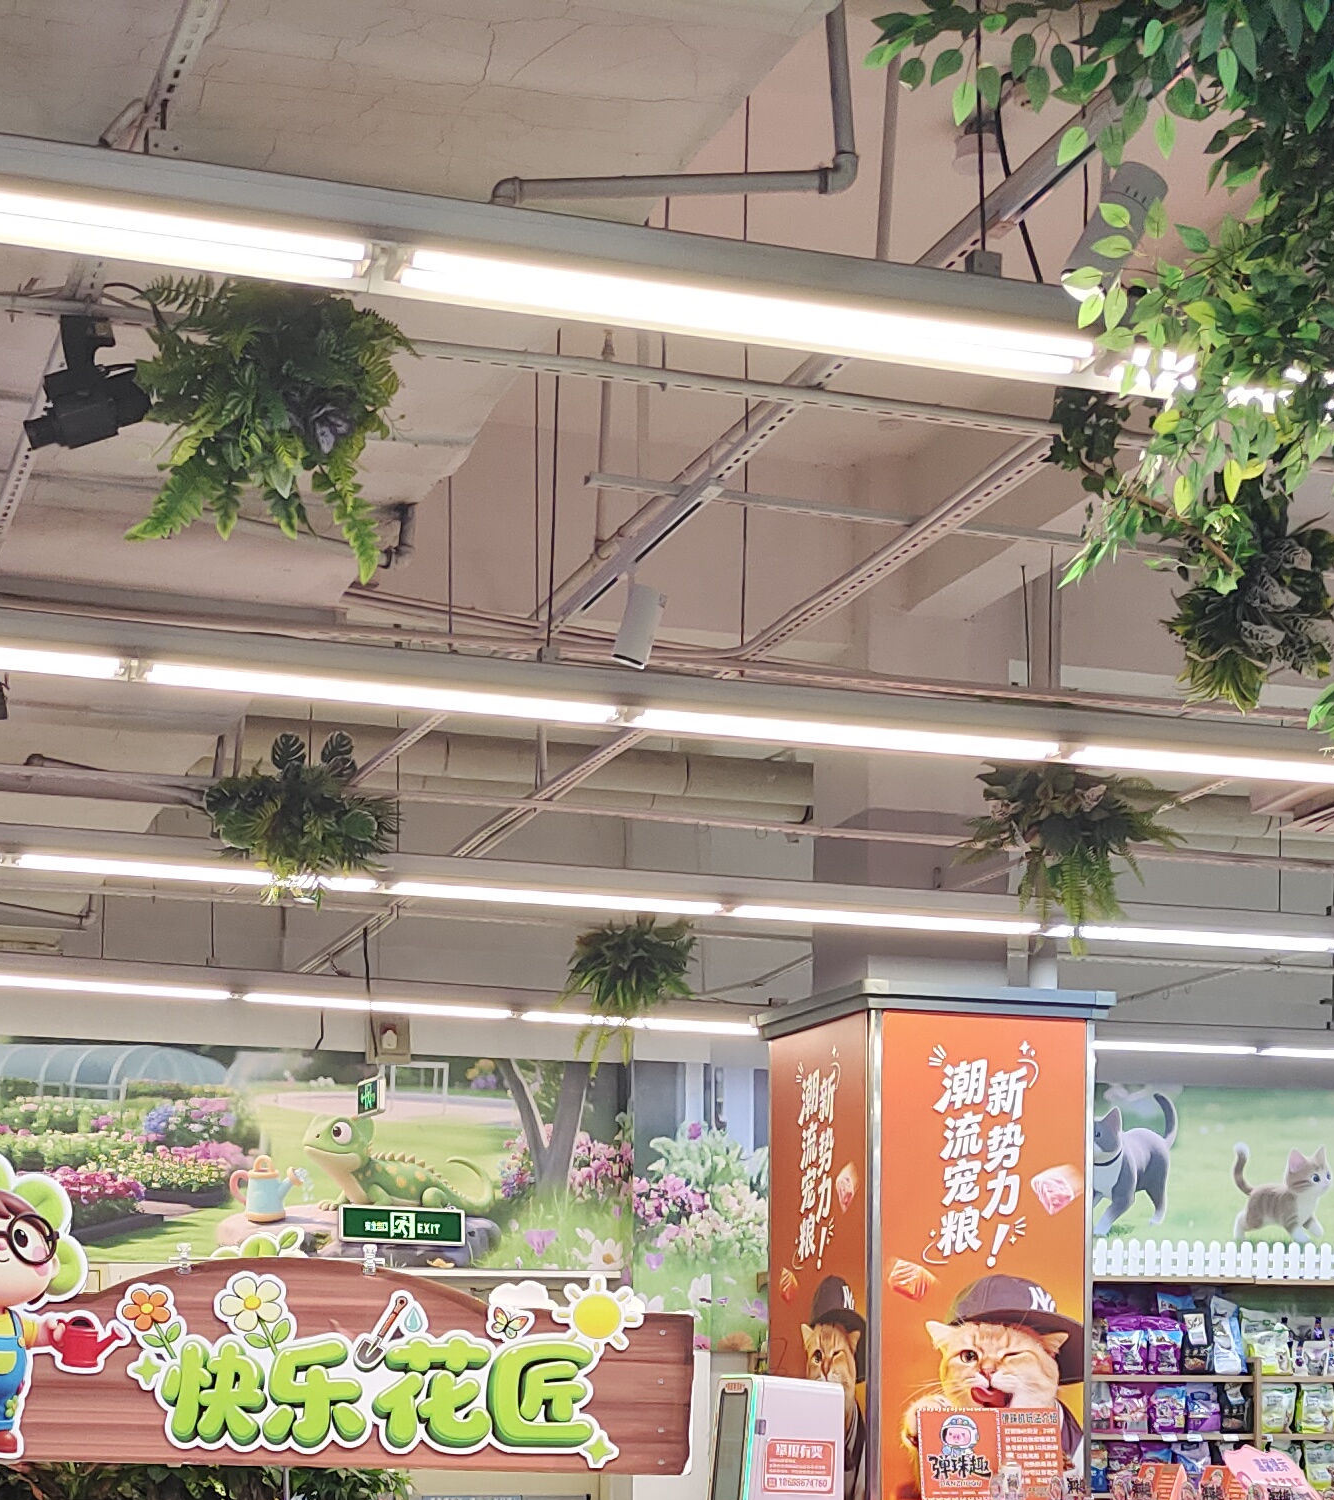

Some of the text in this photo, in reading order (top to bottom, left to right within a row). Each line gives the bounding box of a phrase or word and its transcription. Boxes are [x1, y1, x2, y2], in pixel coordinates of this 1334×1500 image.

[417, 1222, 441, 1235] EXIT
[798, 1069, 819, 1262] 潮流宠粮
[815, 1071, 837, 1270] 新势力！
[932, 1059, 988, 1257] 潮流宠粮
[981, 1067, 1028, 1268] 新势力！
[161, 1336, 595, 1448] 快乐花匠
[927, 1454, 992, 1480] 弹珠趣
